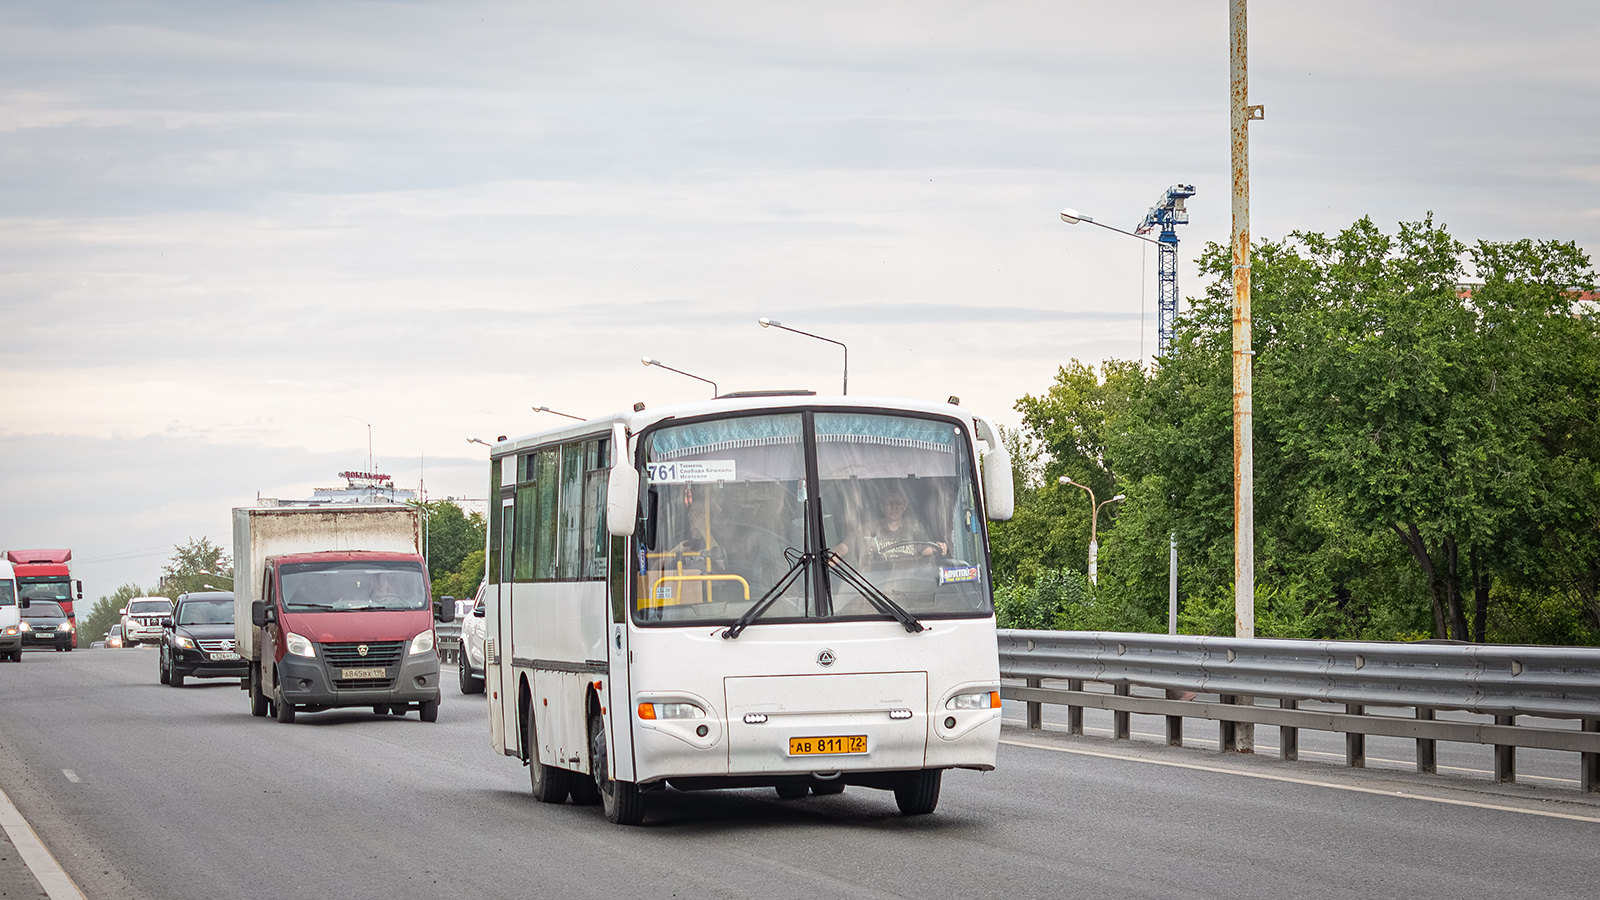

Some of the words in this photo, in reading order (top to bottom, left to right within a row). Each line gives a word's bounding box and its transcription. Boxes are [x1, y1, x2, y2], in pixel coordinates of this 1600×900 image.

[648, 464, 676, 481] 761
[796, 743, 812, 752] АВ
[817, 739, 842, 752] 811
[850, 737, 862, 747] 72
